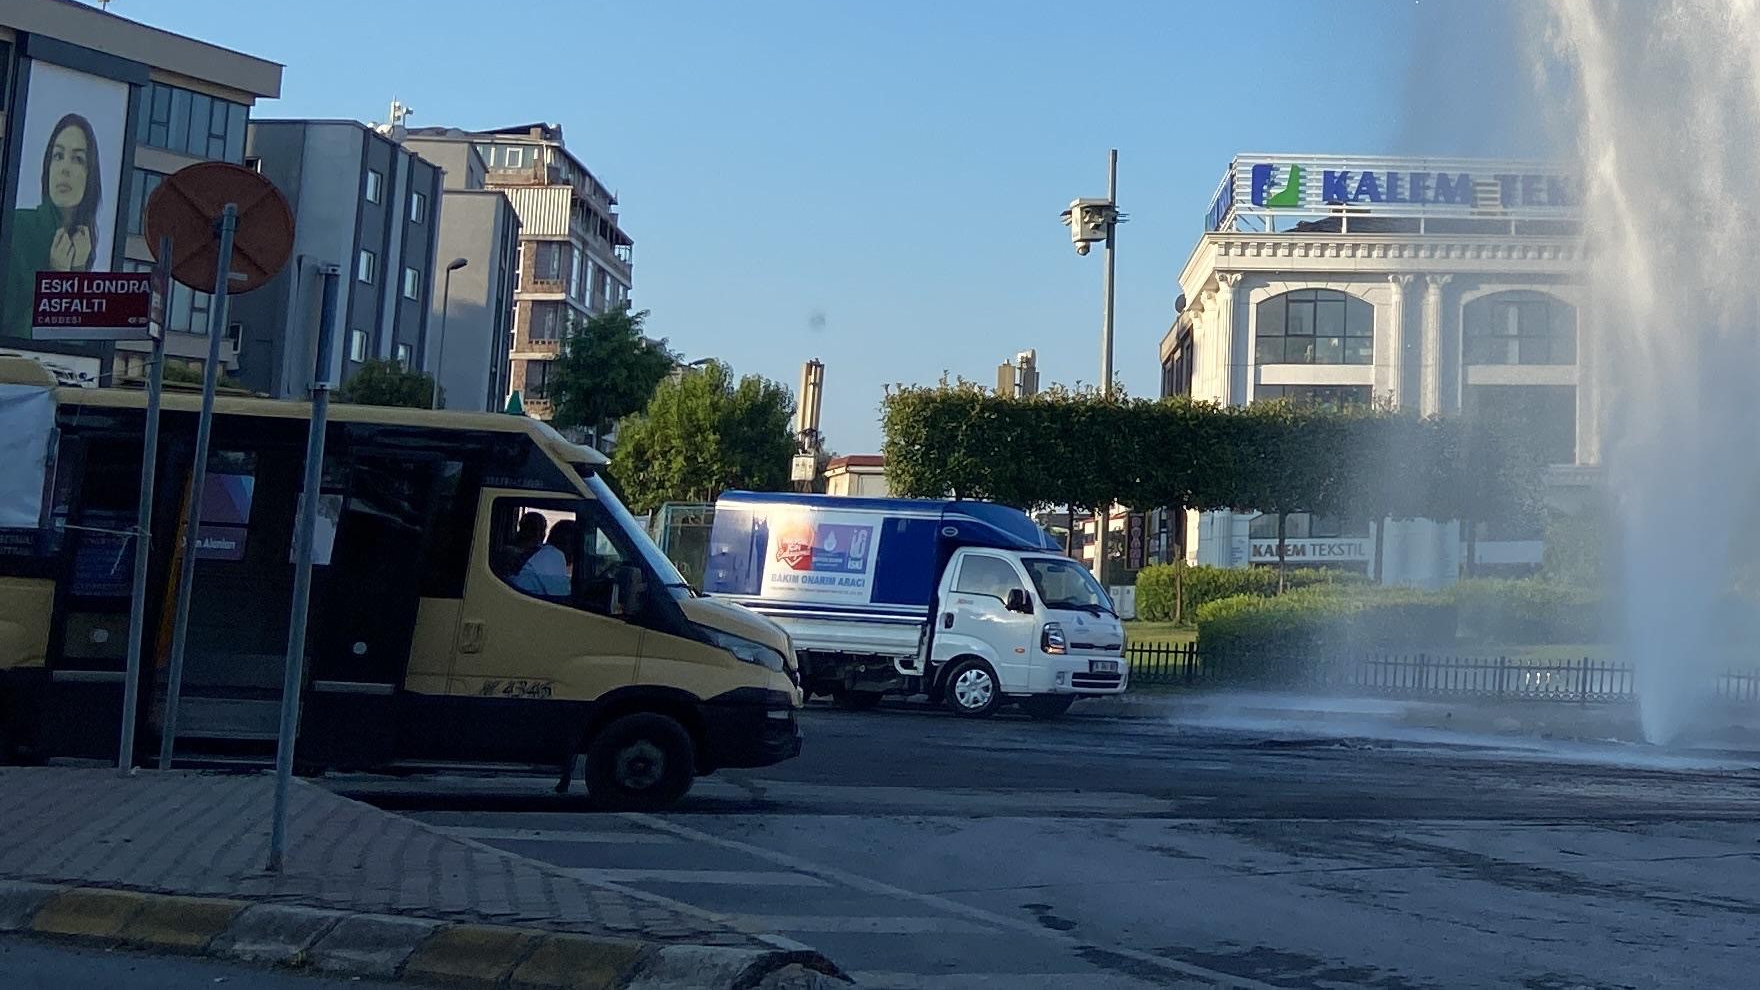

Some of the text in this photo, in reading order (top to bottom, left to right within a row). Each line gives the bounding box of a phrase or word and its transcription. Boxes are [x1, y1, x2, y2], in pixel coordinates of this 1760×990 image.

[1322, 170, 1473, 204] KALEM
[41, 277, 151, 293] ESKİ LONDRA
[39, 299, 106, 312] ASFALTI
[1252, 544, 1306, 557] KALEM
[771, 574, 865, 587] BAKIM ONARIM ARACI
